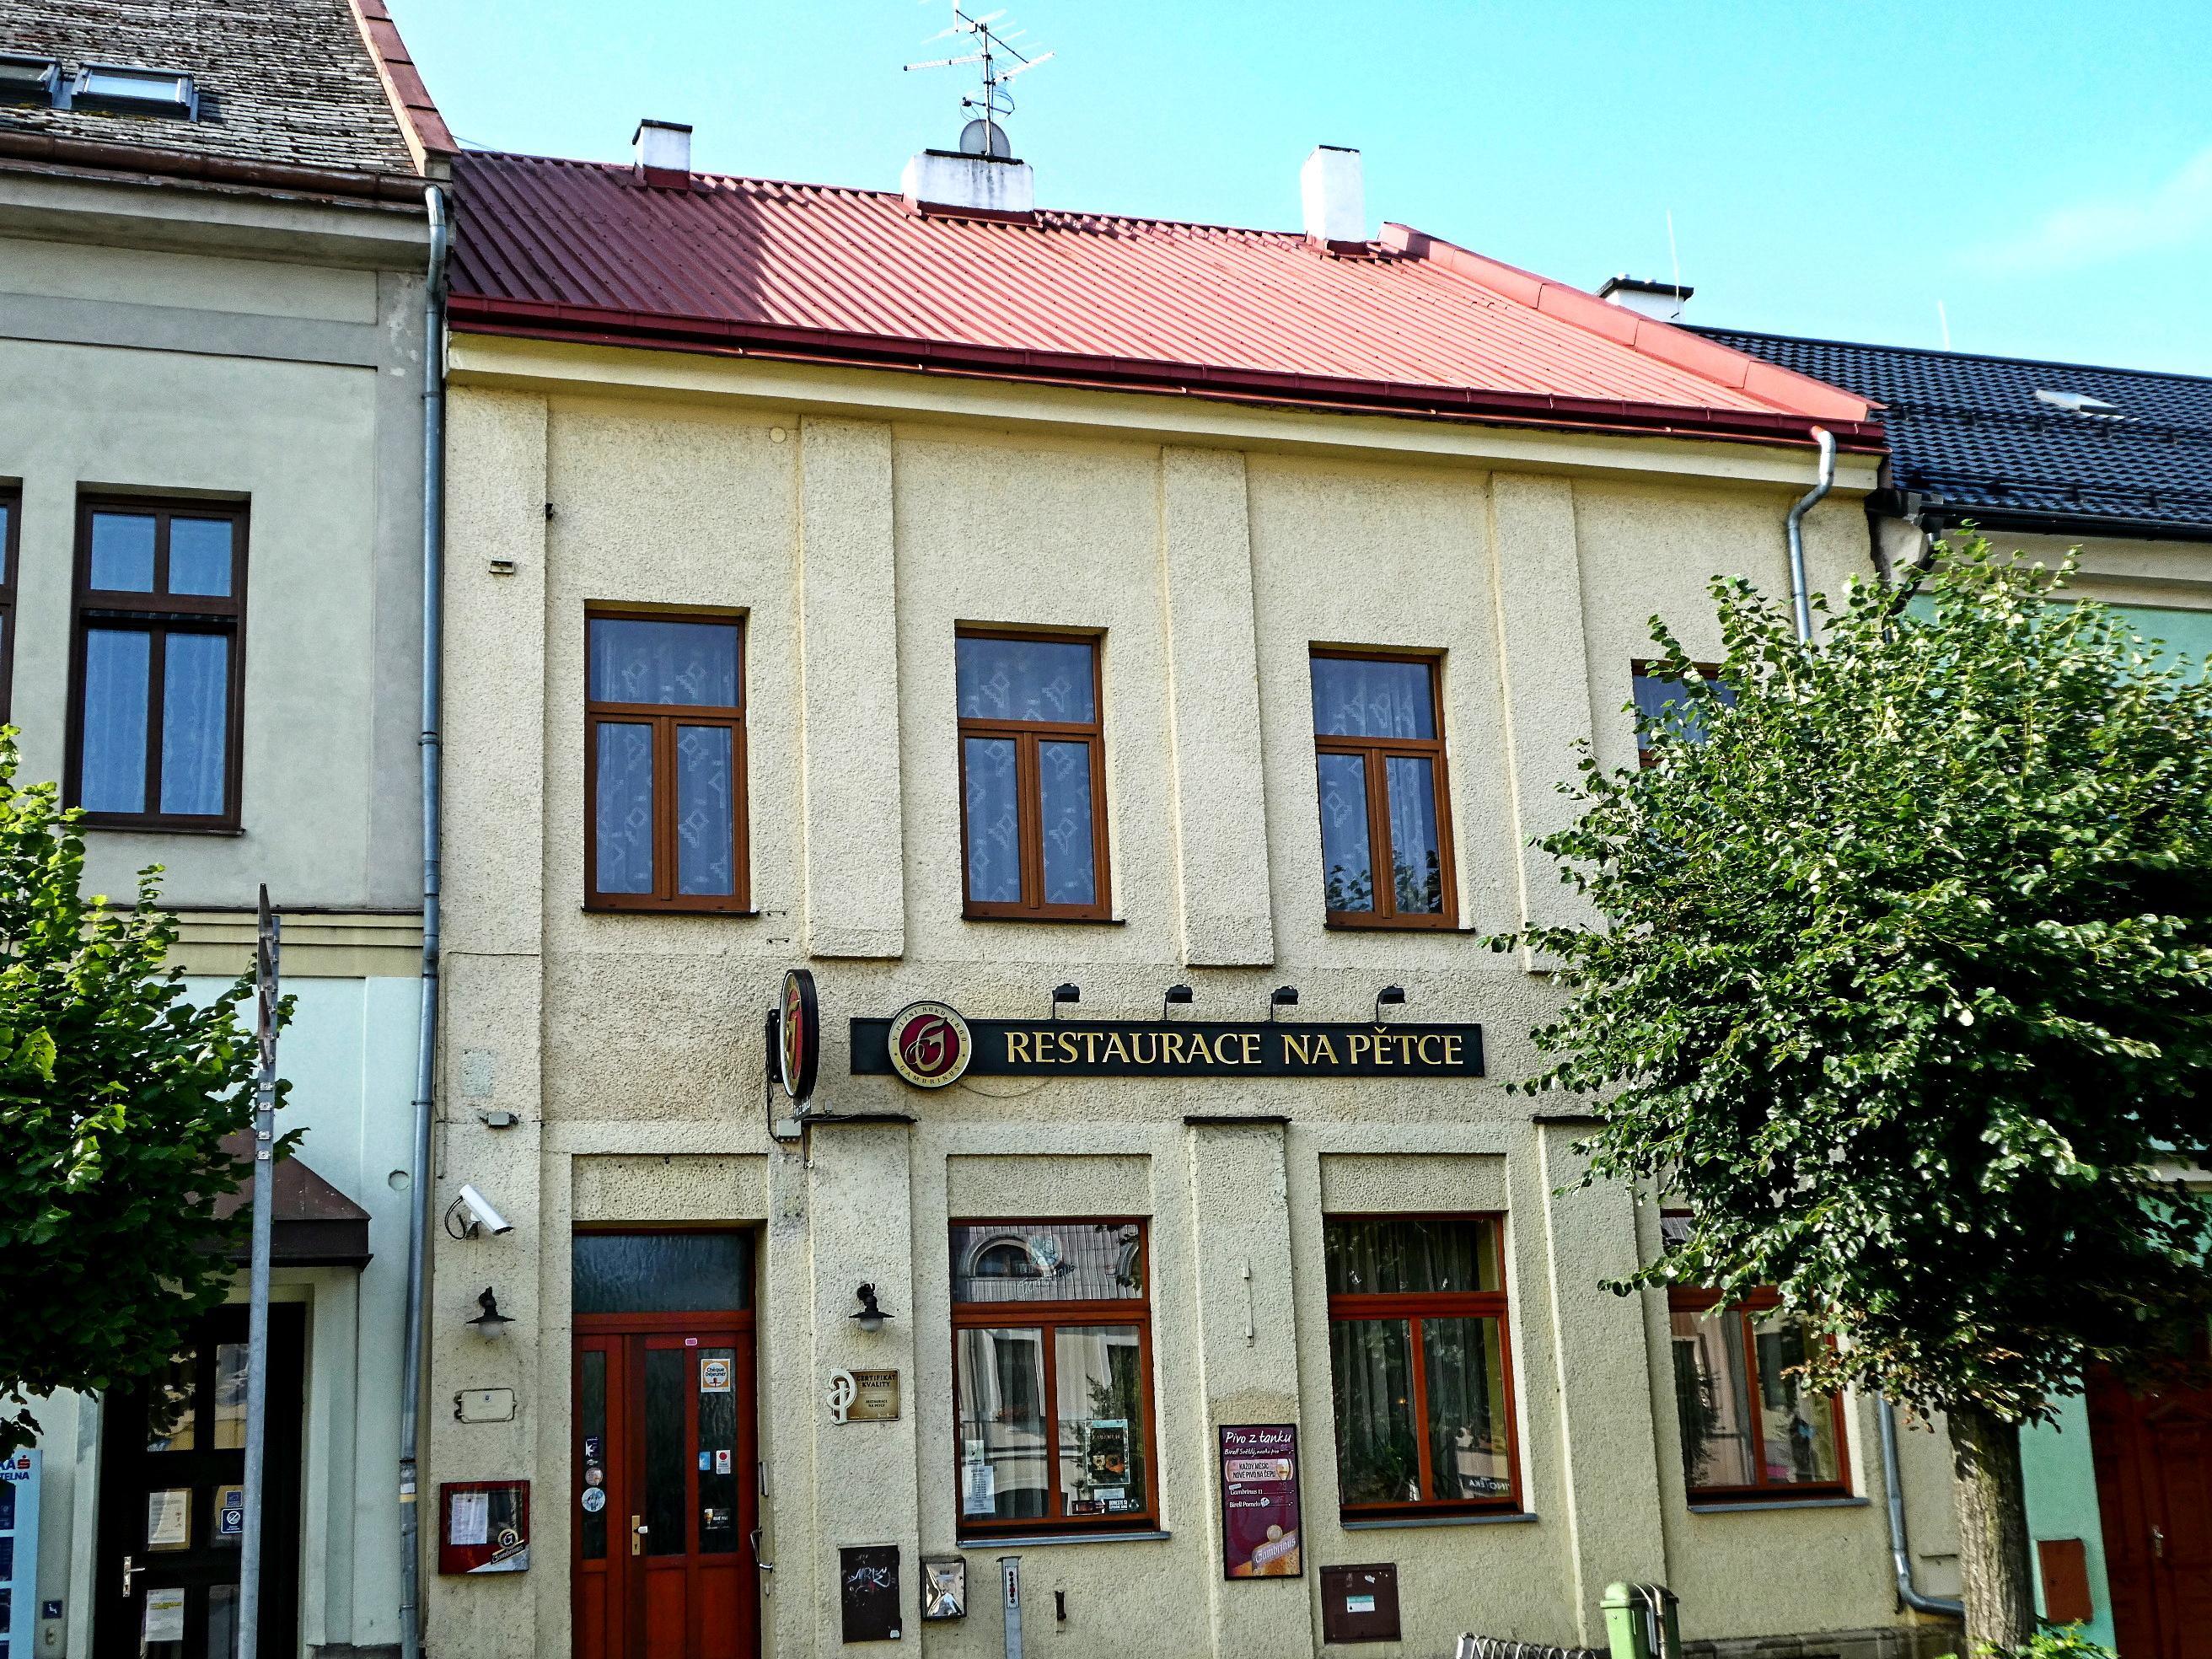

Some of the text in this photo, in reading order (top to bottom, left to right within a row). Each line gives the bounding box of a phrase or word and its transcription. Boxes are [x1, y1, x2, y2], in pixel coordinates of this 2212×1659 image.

[1004, 1026, 1463, 1065] RESTAURACE NA PĚTCE
[899, 1065, 960, 1085] GAMBRINUS
[856, 1373, 896, 1382] CERTIFIKÁT
[1225, 1431, 1247, 1444] Pivo
[1259, 1430, 1291, 1443] tanku
[1254, 1538, 1296, 1564] Gambrinus
